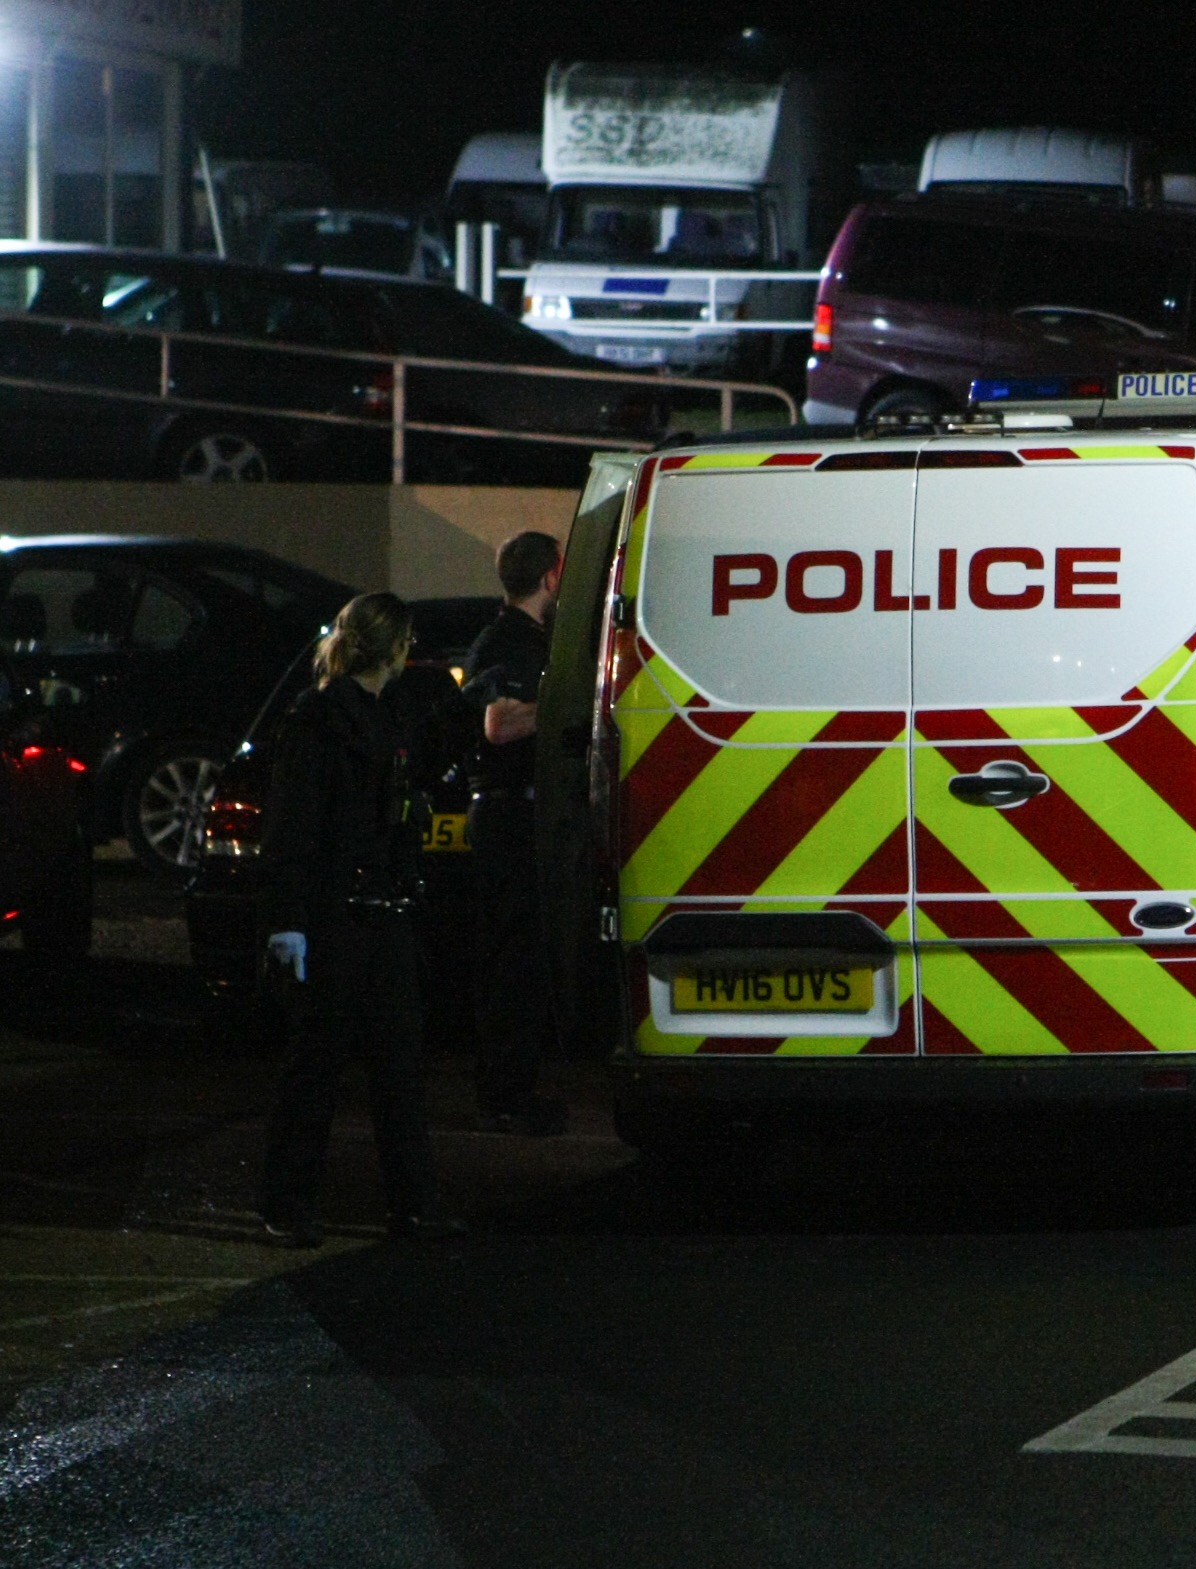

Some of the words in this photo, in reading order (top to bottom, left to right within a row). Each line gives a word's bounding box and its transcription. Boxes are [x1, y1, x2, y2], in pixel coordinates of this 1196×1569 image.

[712, 547, 1121, 616] POLICE
[697, 969, 772, 1001] HV16
[784, 968, 850, 1001] OVS
